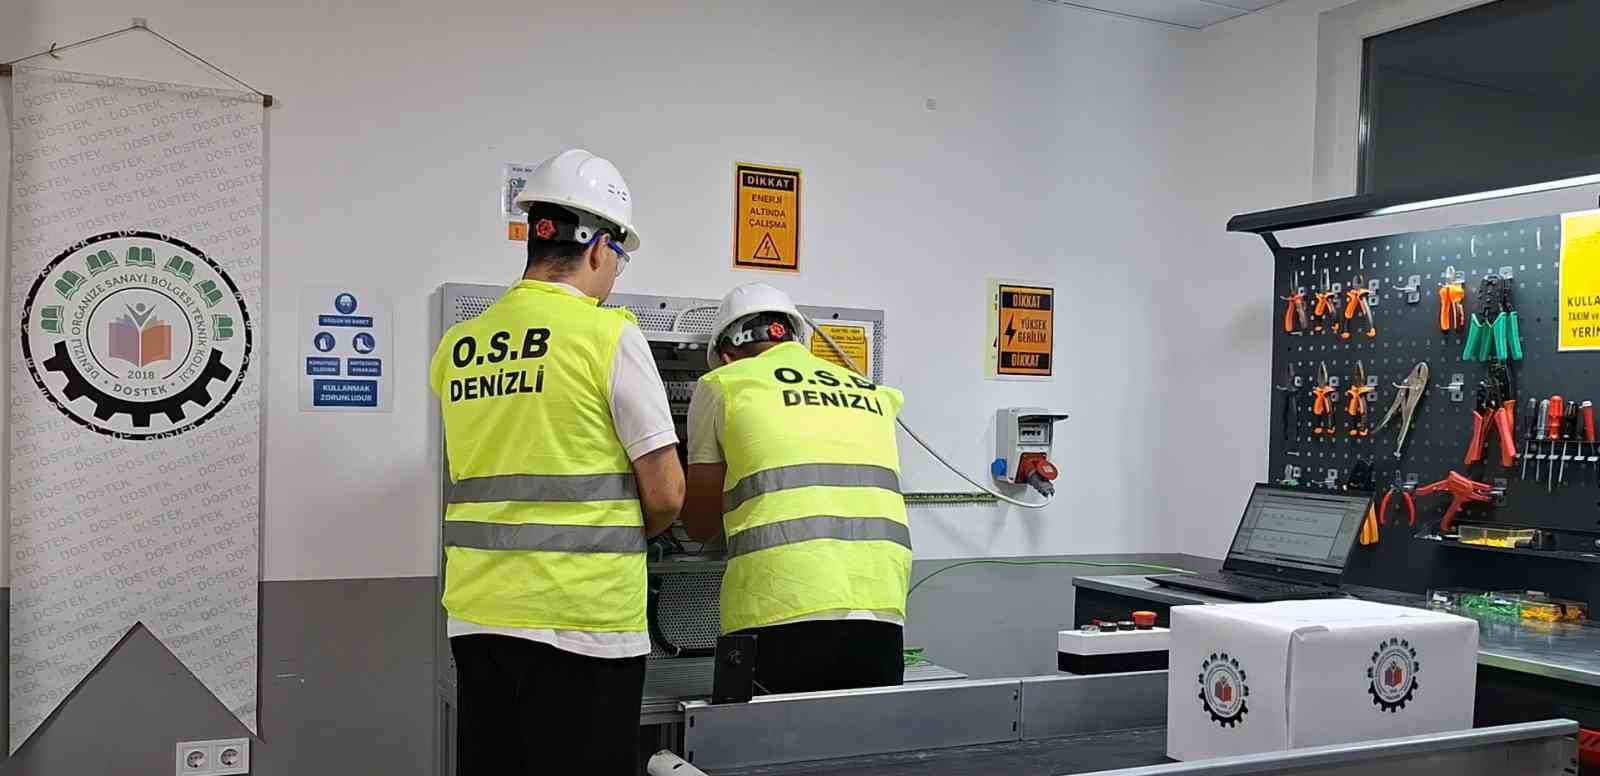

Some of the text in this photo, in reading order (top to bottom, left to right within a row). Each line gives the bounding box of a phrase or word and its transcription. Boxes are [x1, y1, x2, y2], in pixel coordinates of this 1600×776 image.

[747, 176, 790, 188] DİKKAT
[752, 194, 782, 204] ENERJİ
[748, 219, 786, 229] ÇALIŞMA
[750, 208, 786, 217] ALTINDA
[105, 272, 147, 289] SANAYİ
[1012, 292, 1040, 308] DİKKAT
[1021, 317, 1047, 330] YÜKSEK
[1568, 312, 1590, 320] TAKIM
[452, 327, 550, 368] O.S.B
[1018, 330, 1047, 344] GERİLİM
[1012, 352, 1040, 367] DİKKAT
[128, 371, 154, 380] 2018
[450, 365, 544, 402] DENİZLİ
[113, 384, 167, 396] DOSTEK
[782, 390, 884, 416] DENİZLİ
[31, 445, 85, 471] DOSTEK
[34, 424, 237, 503] DOSTEK DOSTEK DOSTEK
[75, 446, 128, 472] DOSTEK
[77, 479, 130, 505] DOSTEK
[158, 450, 210, 476] DOSTEK
[48, 506, 101, 532] DOSTEK
[120, 480, 172, 506] DOSTEK
[199, 452, 249, 478] DOSTEK
[17, 535, 71, 561] DOSTEK
[90, 508, 143, 534] DOSTEK
[160, 482, 213, 508] DOSTEK
[61, 535, 114, 561] DOSTEK
[132, 508, 185, 534] DOSTEK
[202, 482, 252, 508] DOSTEK
[30, 564, 84, 590] DOSTEK
[103, 536, 156, 562] DOSTEK
[174, 510, 224, 536] DOSTEK
[74, 564, 127, 590] DOSTEK
[144, 536, 197, 562] DOSTEK
[33, 537, 236, 622] DOSTEK DOSTEK DOSTEK
[76, 596, 129, 622] DOSTEK
[157, 564, 209, 590] DOSTEK
[47, 565, 248, 650] DOSTEK DOSTEK DOSTEK
[201, 595, 251, 622] DOSTEK
[16, 653, 70, 680] DOSTEK
[159, 596, 212, 622] DOSTEK
[173, 623, 223, 649] DOSTEK
